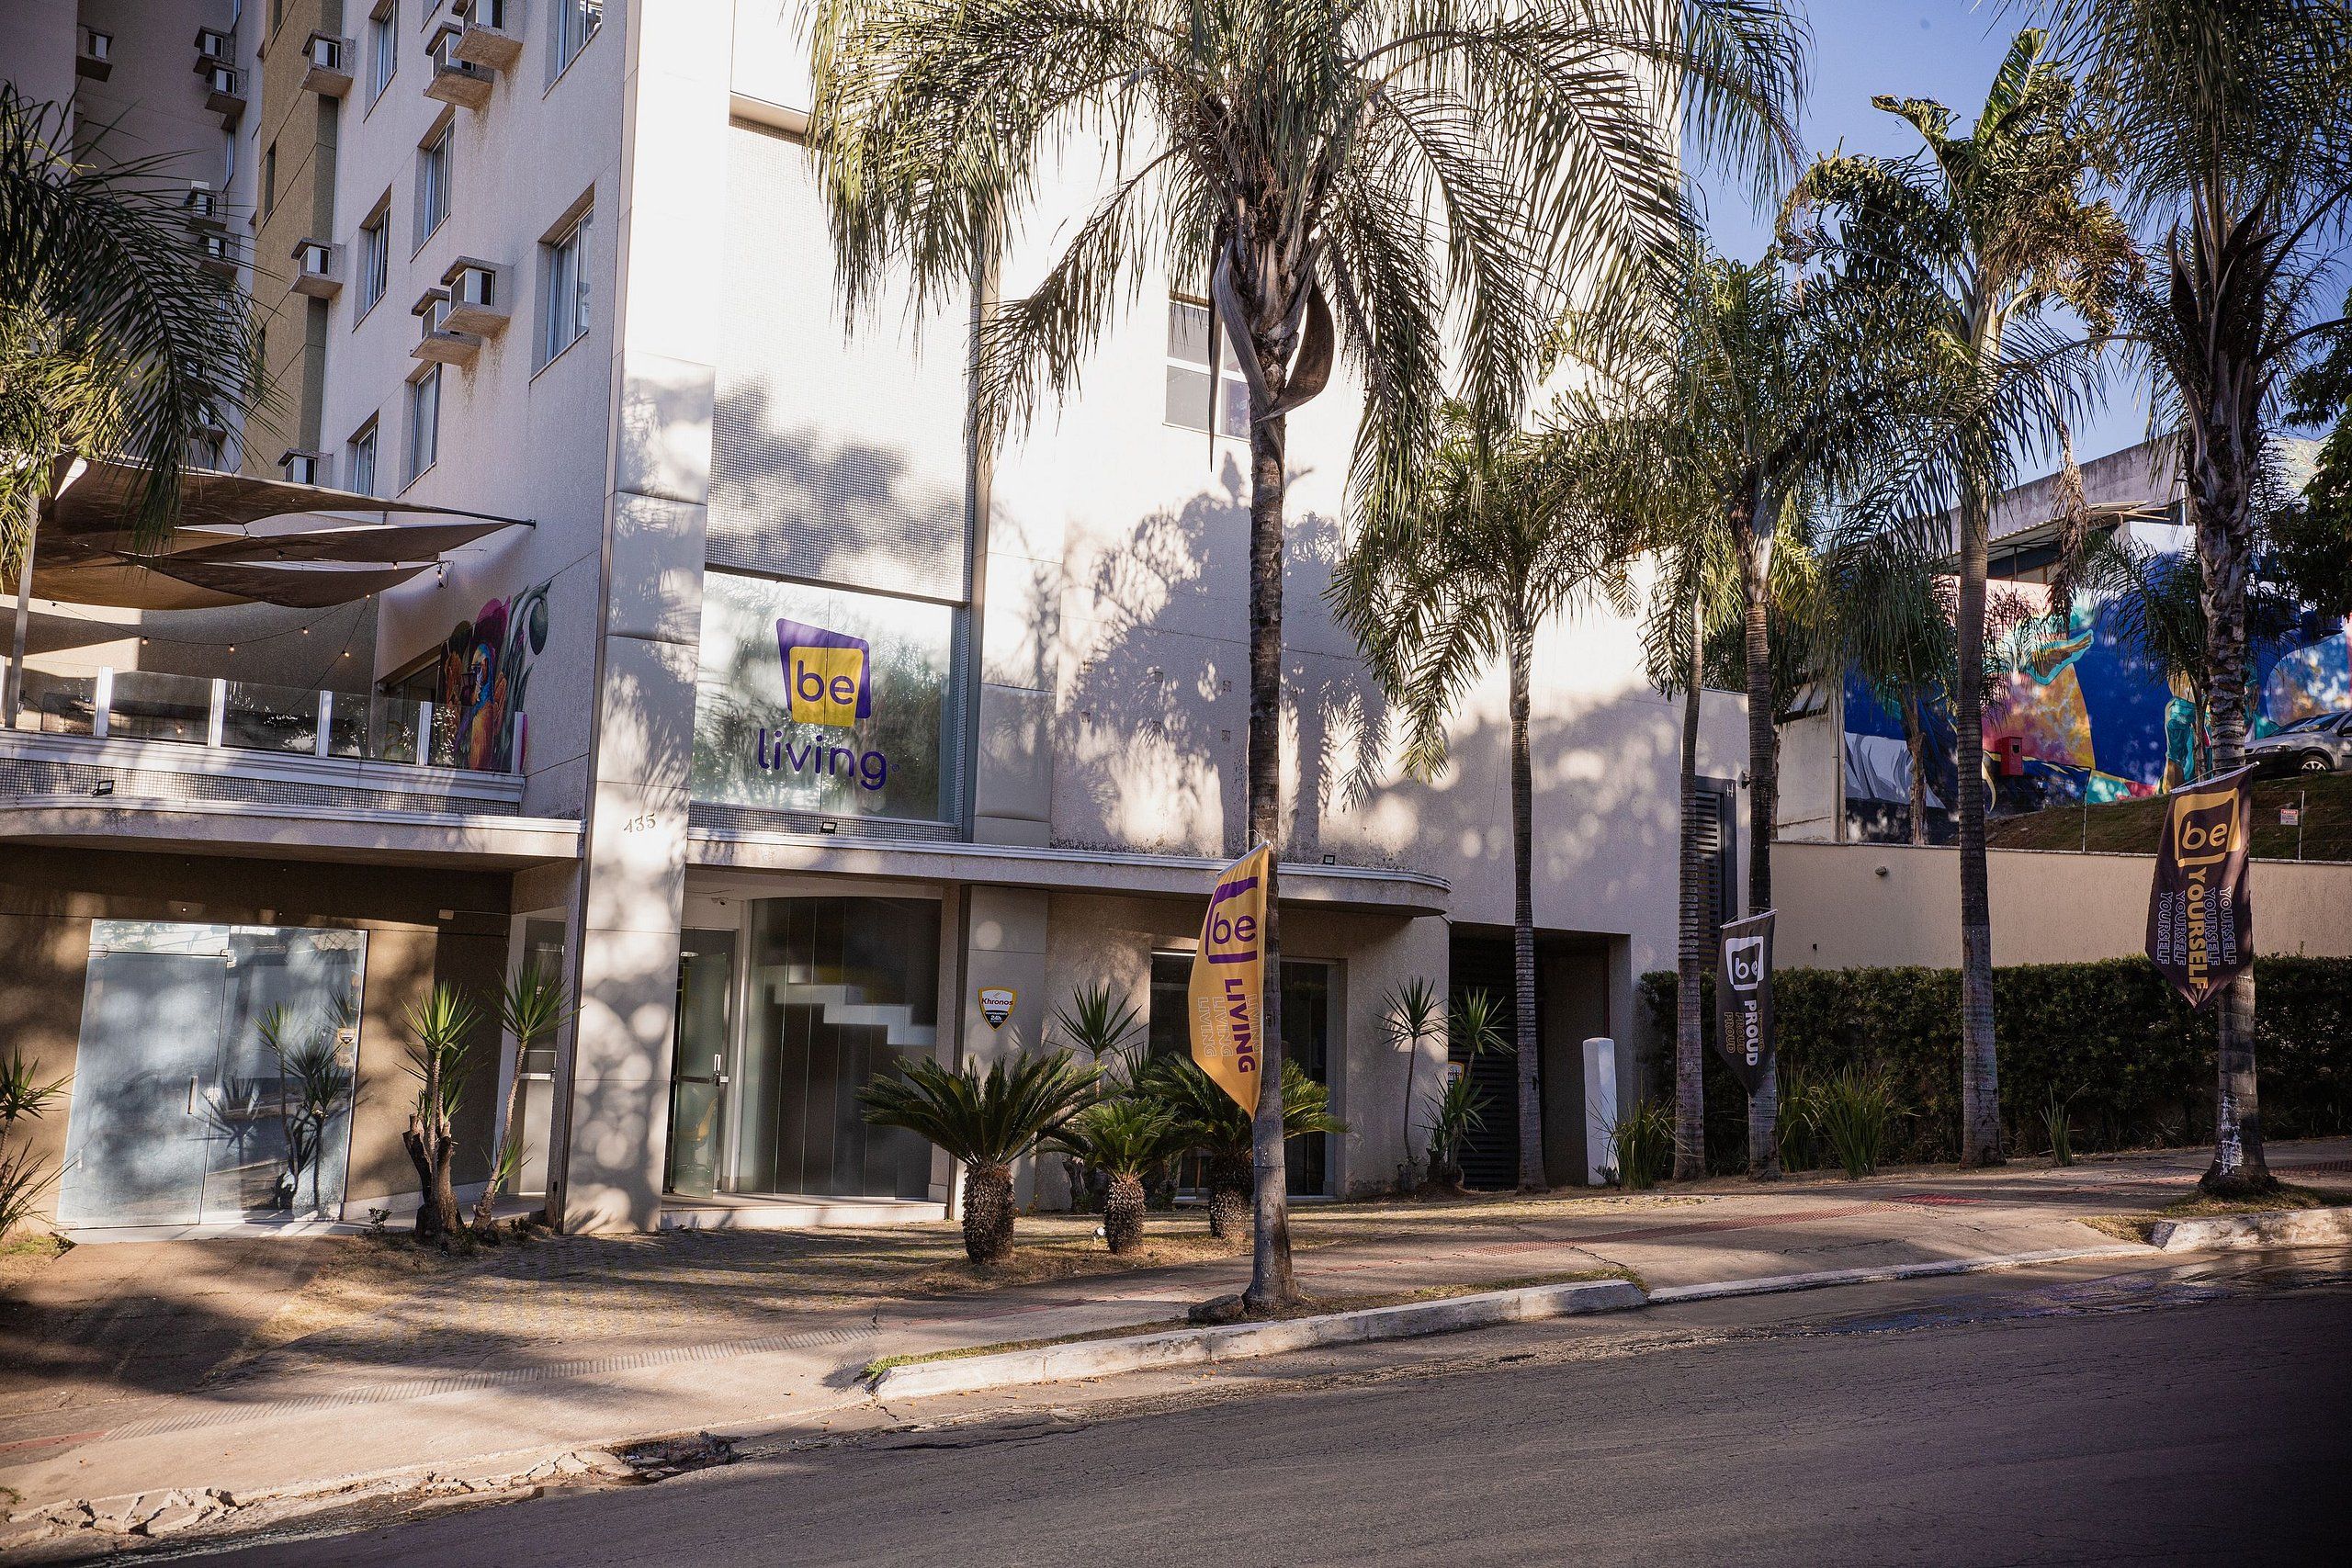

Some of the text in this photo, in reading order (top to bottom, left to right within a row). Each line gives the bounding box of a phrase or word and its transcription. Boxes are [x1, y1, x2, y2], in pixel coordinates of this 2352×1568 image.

[797, 660, 855, 705] be
[758, 728, 887, 791] living
[624, 812, 656, 833] 435
[2181, 820, 2228, 850] be
[1212, 911, 1257, 945] be
[2157, 891, 2174, 965] YOURSELF
[2174, 890, 2187, 966] YOURSELF
[2187, 866, 2210, 989] YOURSELF
[2204, 886, 2221, 966] YOURSELF
[2220, 886, 2237, 965] YOURSELF
[981, 998, 1014, 1006] Khronos
[1198, 997, 1217, 1057] LIVING
[1212, 997, 1234, 1057] LIVING
[1225, 978, 1256, 1074] LIVING
[1745, 999, 1758, 1066] PROUD
[1724, 1012, 1736, 1054] PROUD
